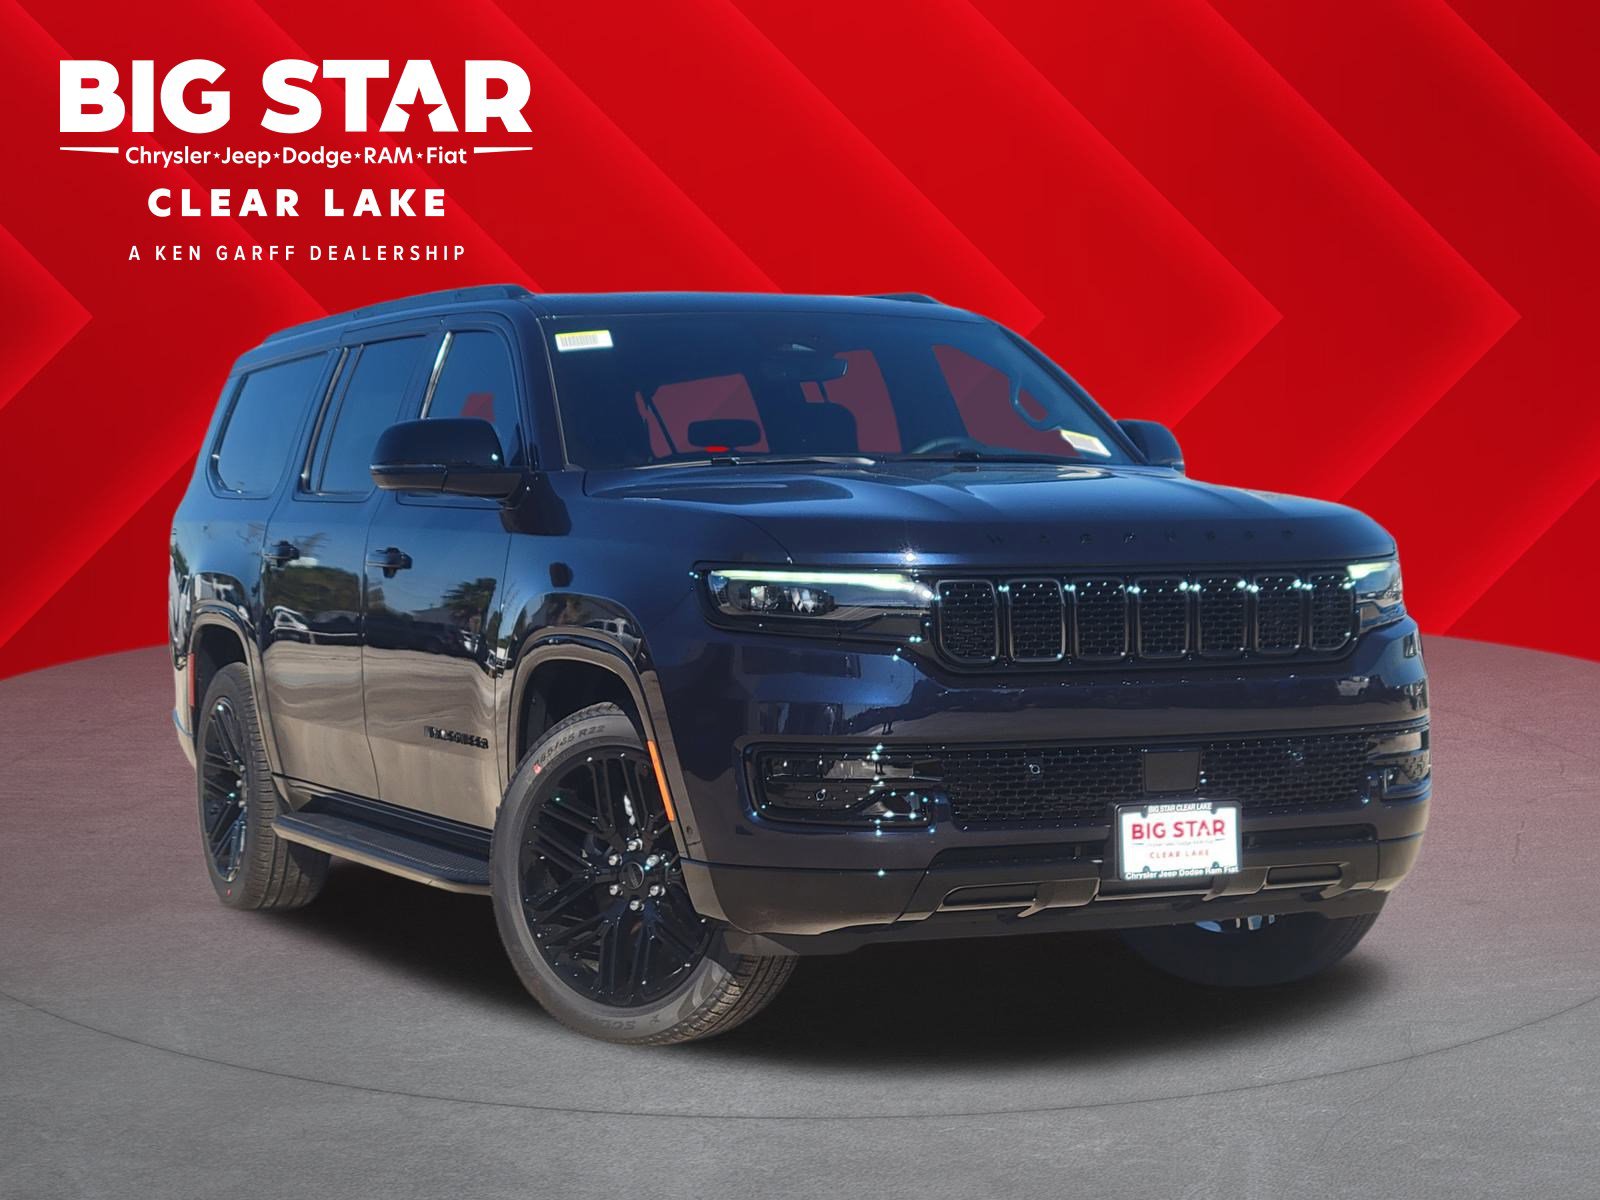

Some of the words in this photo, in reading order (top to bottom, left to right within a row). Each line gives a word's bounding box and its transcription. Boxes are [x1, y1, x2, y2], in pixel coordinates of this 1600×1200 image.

[1147, 804, 1160, 814] BIG
[1160, 804, 1176, 813] STAR
[1176, 803, 1196, 812] CLEAR
[1196, 802, 1213, 811] LAKE
[1131, 822, 1166, 840] BIG
[1173, 819, 1226, 838] STAR
[1149, 850, 1180, 859] CLEAR
[1185, 849, 1209, 857] LAKE
[1125, 870, 1158, 881] Chrysler
[1158, 869, 1178, 879] Jeep
[1179, 867, 1204, 877] Dodge
[1223, 865, 1239, 874] Fiat
